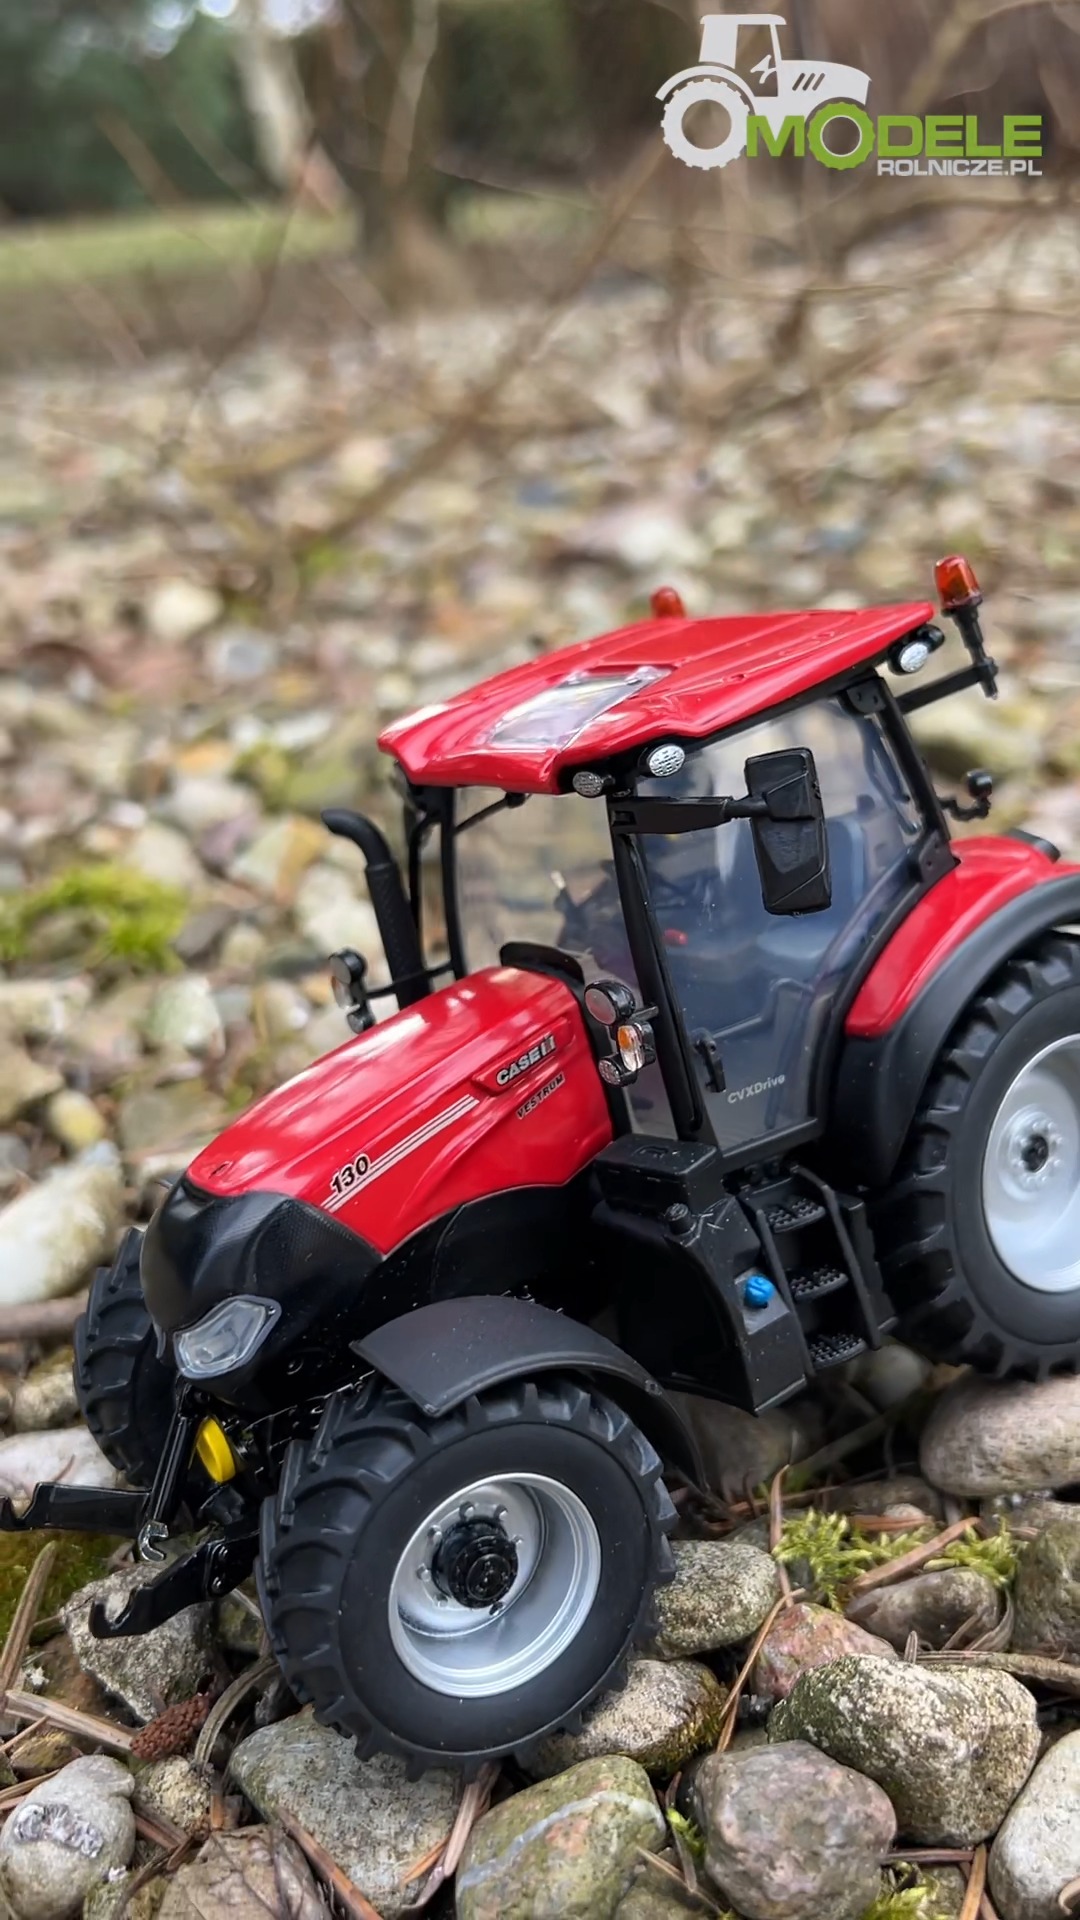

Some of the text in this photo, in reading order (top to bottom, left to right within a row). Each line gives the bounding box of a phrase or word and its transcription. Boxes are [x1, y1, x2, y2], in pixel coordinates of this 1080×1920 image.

[497, 1046, 541, 1085] CASE
[516, 1073, 565, 1119] VESTRUM
[727, 1074, 786, 1104] CVXDrive
[331, 1155, 370, 1194] 130
